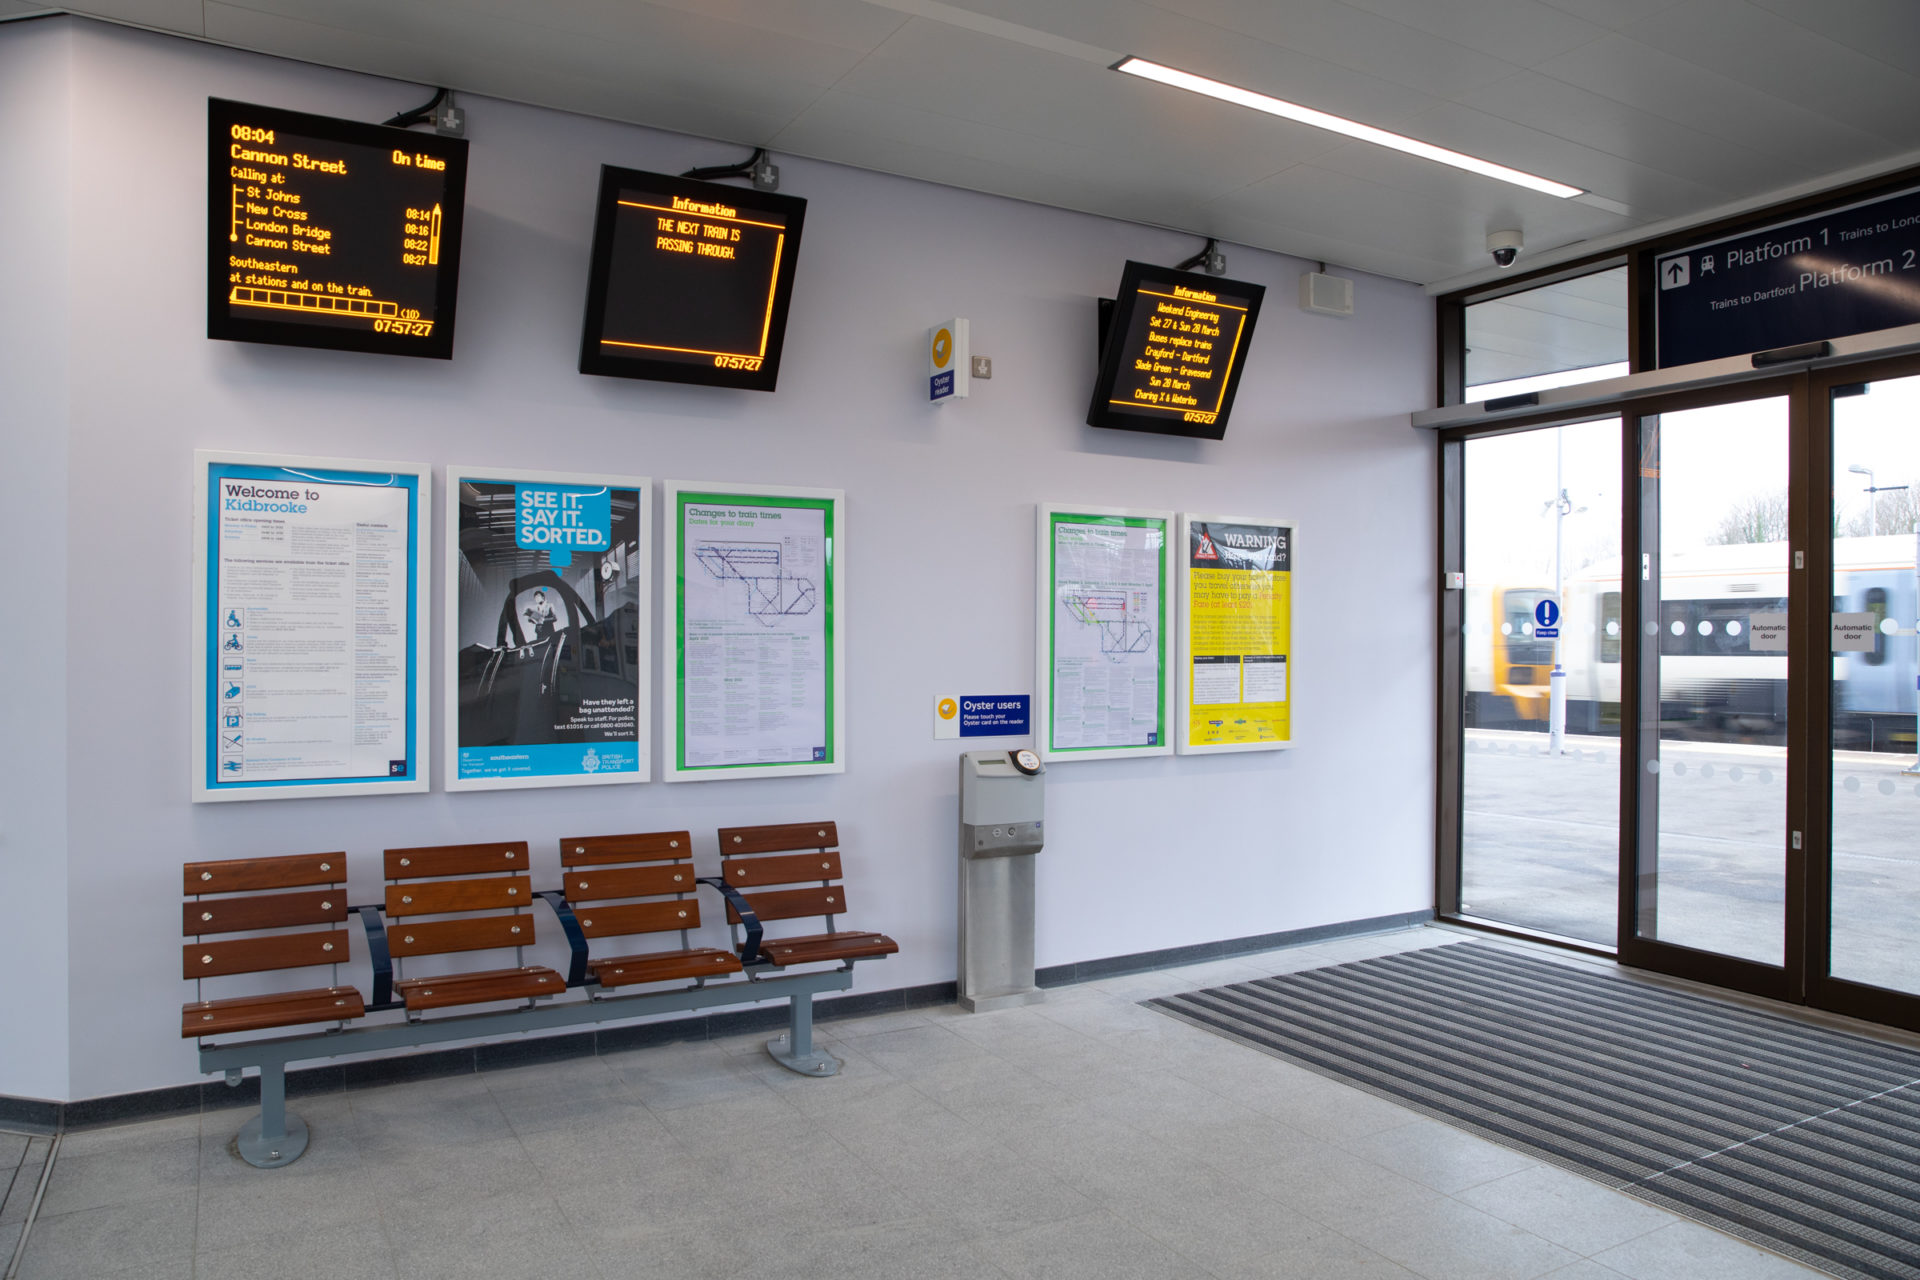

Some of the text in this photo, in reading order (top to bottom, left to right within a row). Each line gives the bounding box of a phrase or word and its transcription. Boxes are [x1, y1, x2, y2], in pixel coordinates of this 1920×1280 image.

[231, 125, 275, 144] 08:04
[231, 145, 347, 174] Cannon Street
[393, 150, 445, 171] On time
[231, 167, 285, 184] Calling at:
[247, 187, 301, 204] St Johns
[246, 203, 308, 220] New Cross
[406, 208, 431, 221] 08:14
[672, 196, 736, 218] Information
[246, 219, 332, 241] London Bridge
[405, 224, 429, 236] 08:16
[658, 218, 741, 241] THE NEXT TRAIN IS
[246, 235, 331, 255] Cannon Street
[404, 239, 428, 251] 08:22
[656, 237, 736, 259] PASSING THROUGH.
[1727, 236, 1811, 269] Platform
[1819, 228, 1829, 246] 1
[1840, 226, 1872, 242] Trains
[1876, 222, 1889, 232] to
[229, 256, 298, 273] Southeastern
[403, 254, 427, 265] 08:27
[229, 272, 373, 297] at stations and on the train.
[1710, 249, 1916, 310] Trains to Dartford Platform 2
[1174, 285, 1216, 302] Information
[400, 310, 420, 319] (10)
[1158, 302, 1219, 324] Weekend Engineering
[374, 320, 432, 336] 07:57:27
[1150, 317, 1162, 327] Sat
[1162, 319, 1172, 328] 27
[1179, 321, 1191, 331] Sun
[1192, 324, 1201, 333] 28
[1201, 325, 1219, 336] March
[1149, 332, 1212, 350] Buses replace trains
[714, 356, 762, 371] 07:57:27
[1145, 346, 1210, 364] Crayford Dartford
[1135, 360, 1212, 378] Slade Green Gravesend
[935, 376, 950, 386] Oyster
[1150, 377, 1191, 390] Sun 28 March
[935, 385, 949, 395] reader
[1135, 389, 1158, 403] Charing
[1159, 392, 1165, 401] X
[1172, 393, 1197, 405] Waterloo
[1184, 412, 1217, 424] 07:57:27
[226, 485, 319, 500] Welcome to
[521, 491, 583, 509] SEE IT.
[225, 499, 308, 513] Kidbrooke
[689, 508, 726, 518] Changes
[521, 509, 583, 527] SAY IT.
[521, 527, 607, 545] SORTED.
[1058, 527, 1085, 535] Changes
[1224, 534, 1286, 549] WARNING
[1217, 572, 1230, 581] buy
[601, 699, 616, 707] they
[963, 701, 1021, 712] Oyster users
